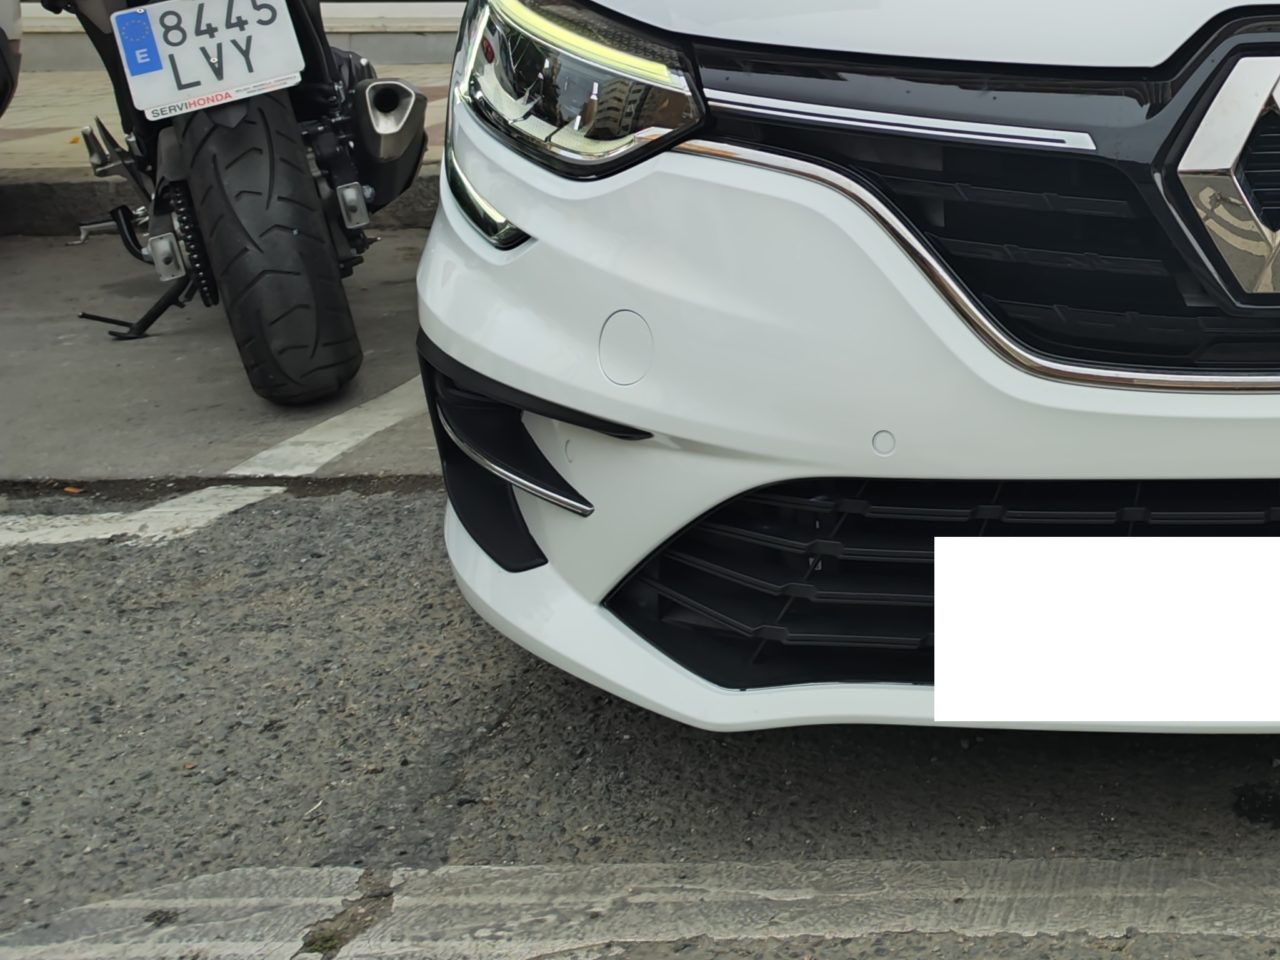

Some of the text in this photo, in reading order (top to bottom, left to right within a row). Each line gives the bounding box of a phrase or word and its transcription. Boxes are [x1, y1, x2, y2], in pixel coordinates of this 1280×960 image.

[135, 48, 150, 64] E
[168, 35, 254, 91] LVY
[151, 91, 232, 119] SERVIHONDA
